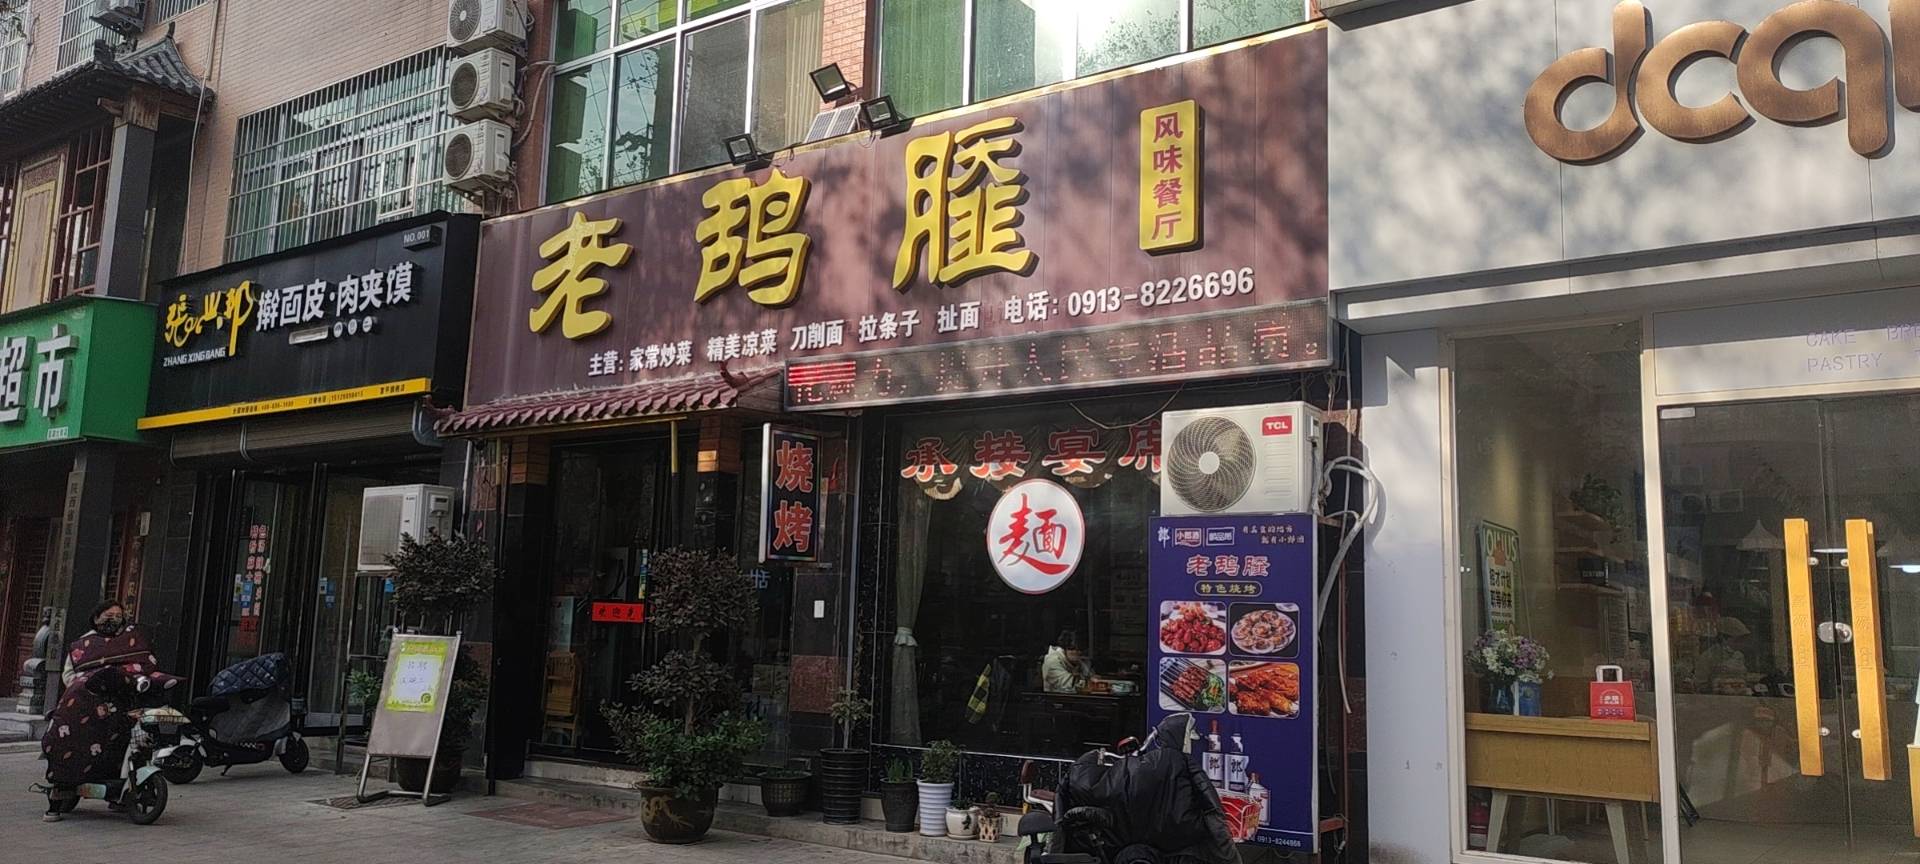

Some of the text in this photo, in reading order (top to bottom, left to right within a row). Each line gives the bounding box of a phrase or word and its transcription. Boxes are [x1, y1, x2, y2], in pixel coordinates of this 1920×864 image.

[1151, 111, 1184, 240] 风味餐厅
[707, 328, 778, 362] 精美凉菜
[790, 318, 845, 351] 刀削面
[858, 309, 921, 343] 拉条子
[936, 301, 981, 334] 扯面
[1806, 328, 1857, 347] CAKE
[1806, 352, 1882, 373] PASTRY
[1266, 422, 1289, 430] TCL
[772, 440, 815, 553] 烧烤
[1200, 583, 1257, 594] 特色烧烤
